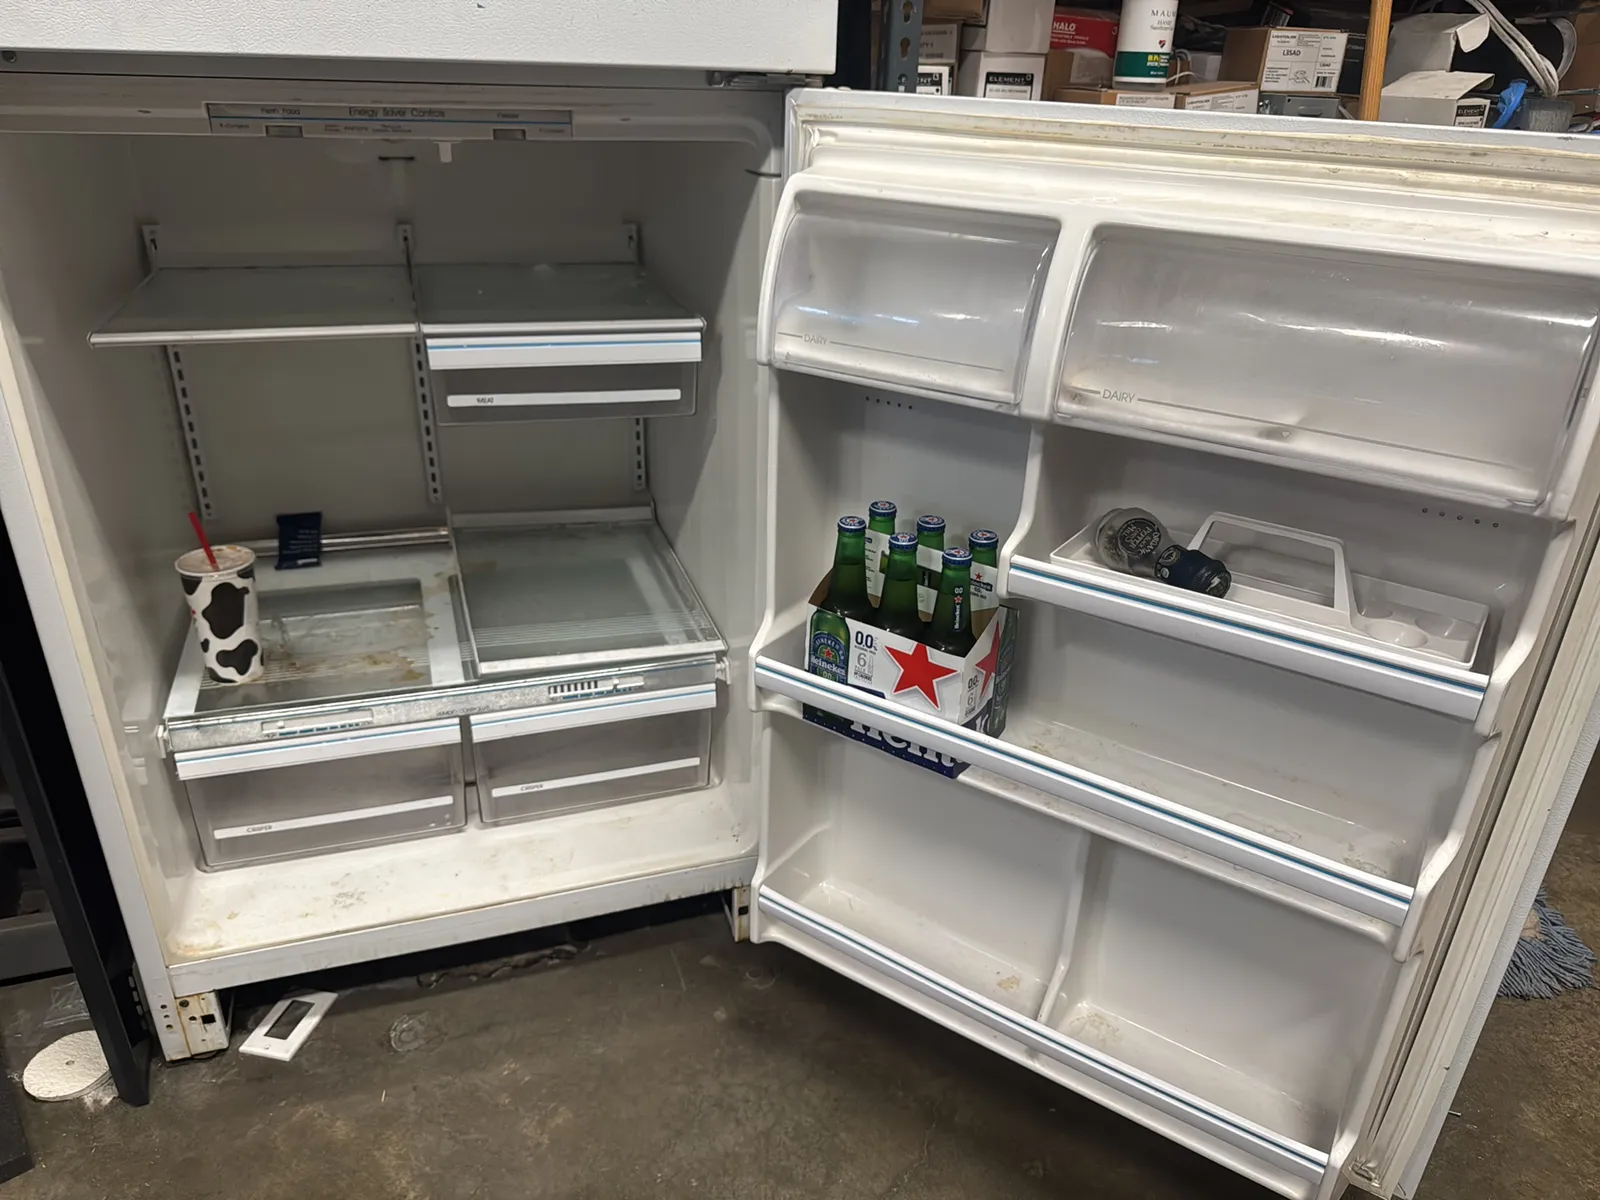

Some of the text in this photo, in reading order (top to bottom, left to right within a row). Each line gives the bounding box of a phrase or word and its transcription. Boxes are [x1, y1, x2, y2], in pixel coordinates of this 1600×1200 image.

[1053, 21, 1076, 32] HALO
[348, 106, 378, 118] Energy
[804, 333, 828, 345] DAIRY
[1102, 388, 1136, 404] DAIRY
[811, 655, 846, 676] Heineken
[857, 652, 867, 668] 6
